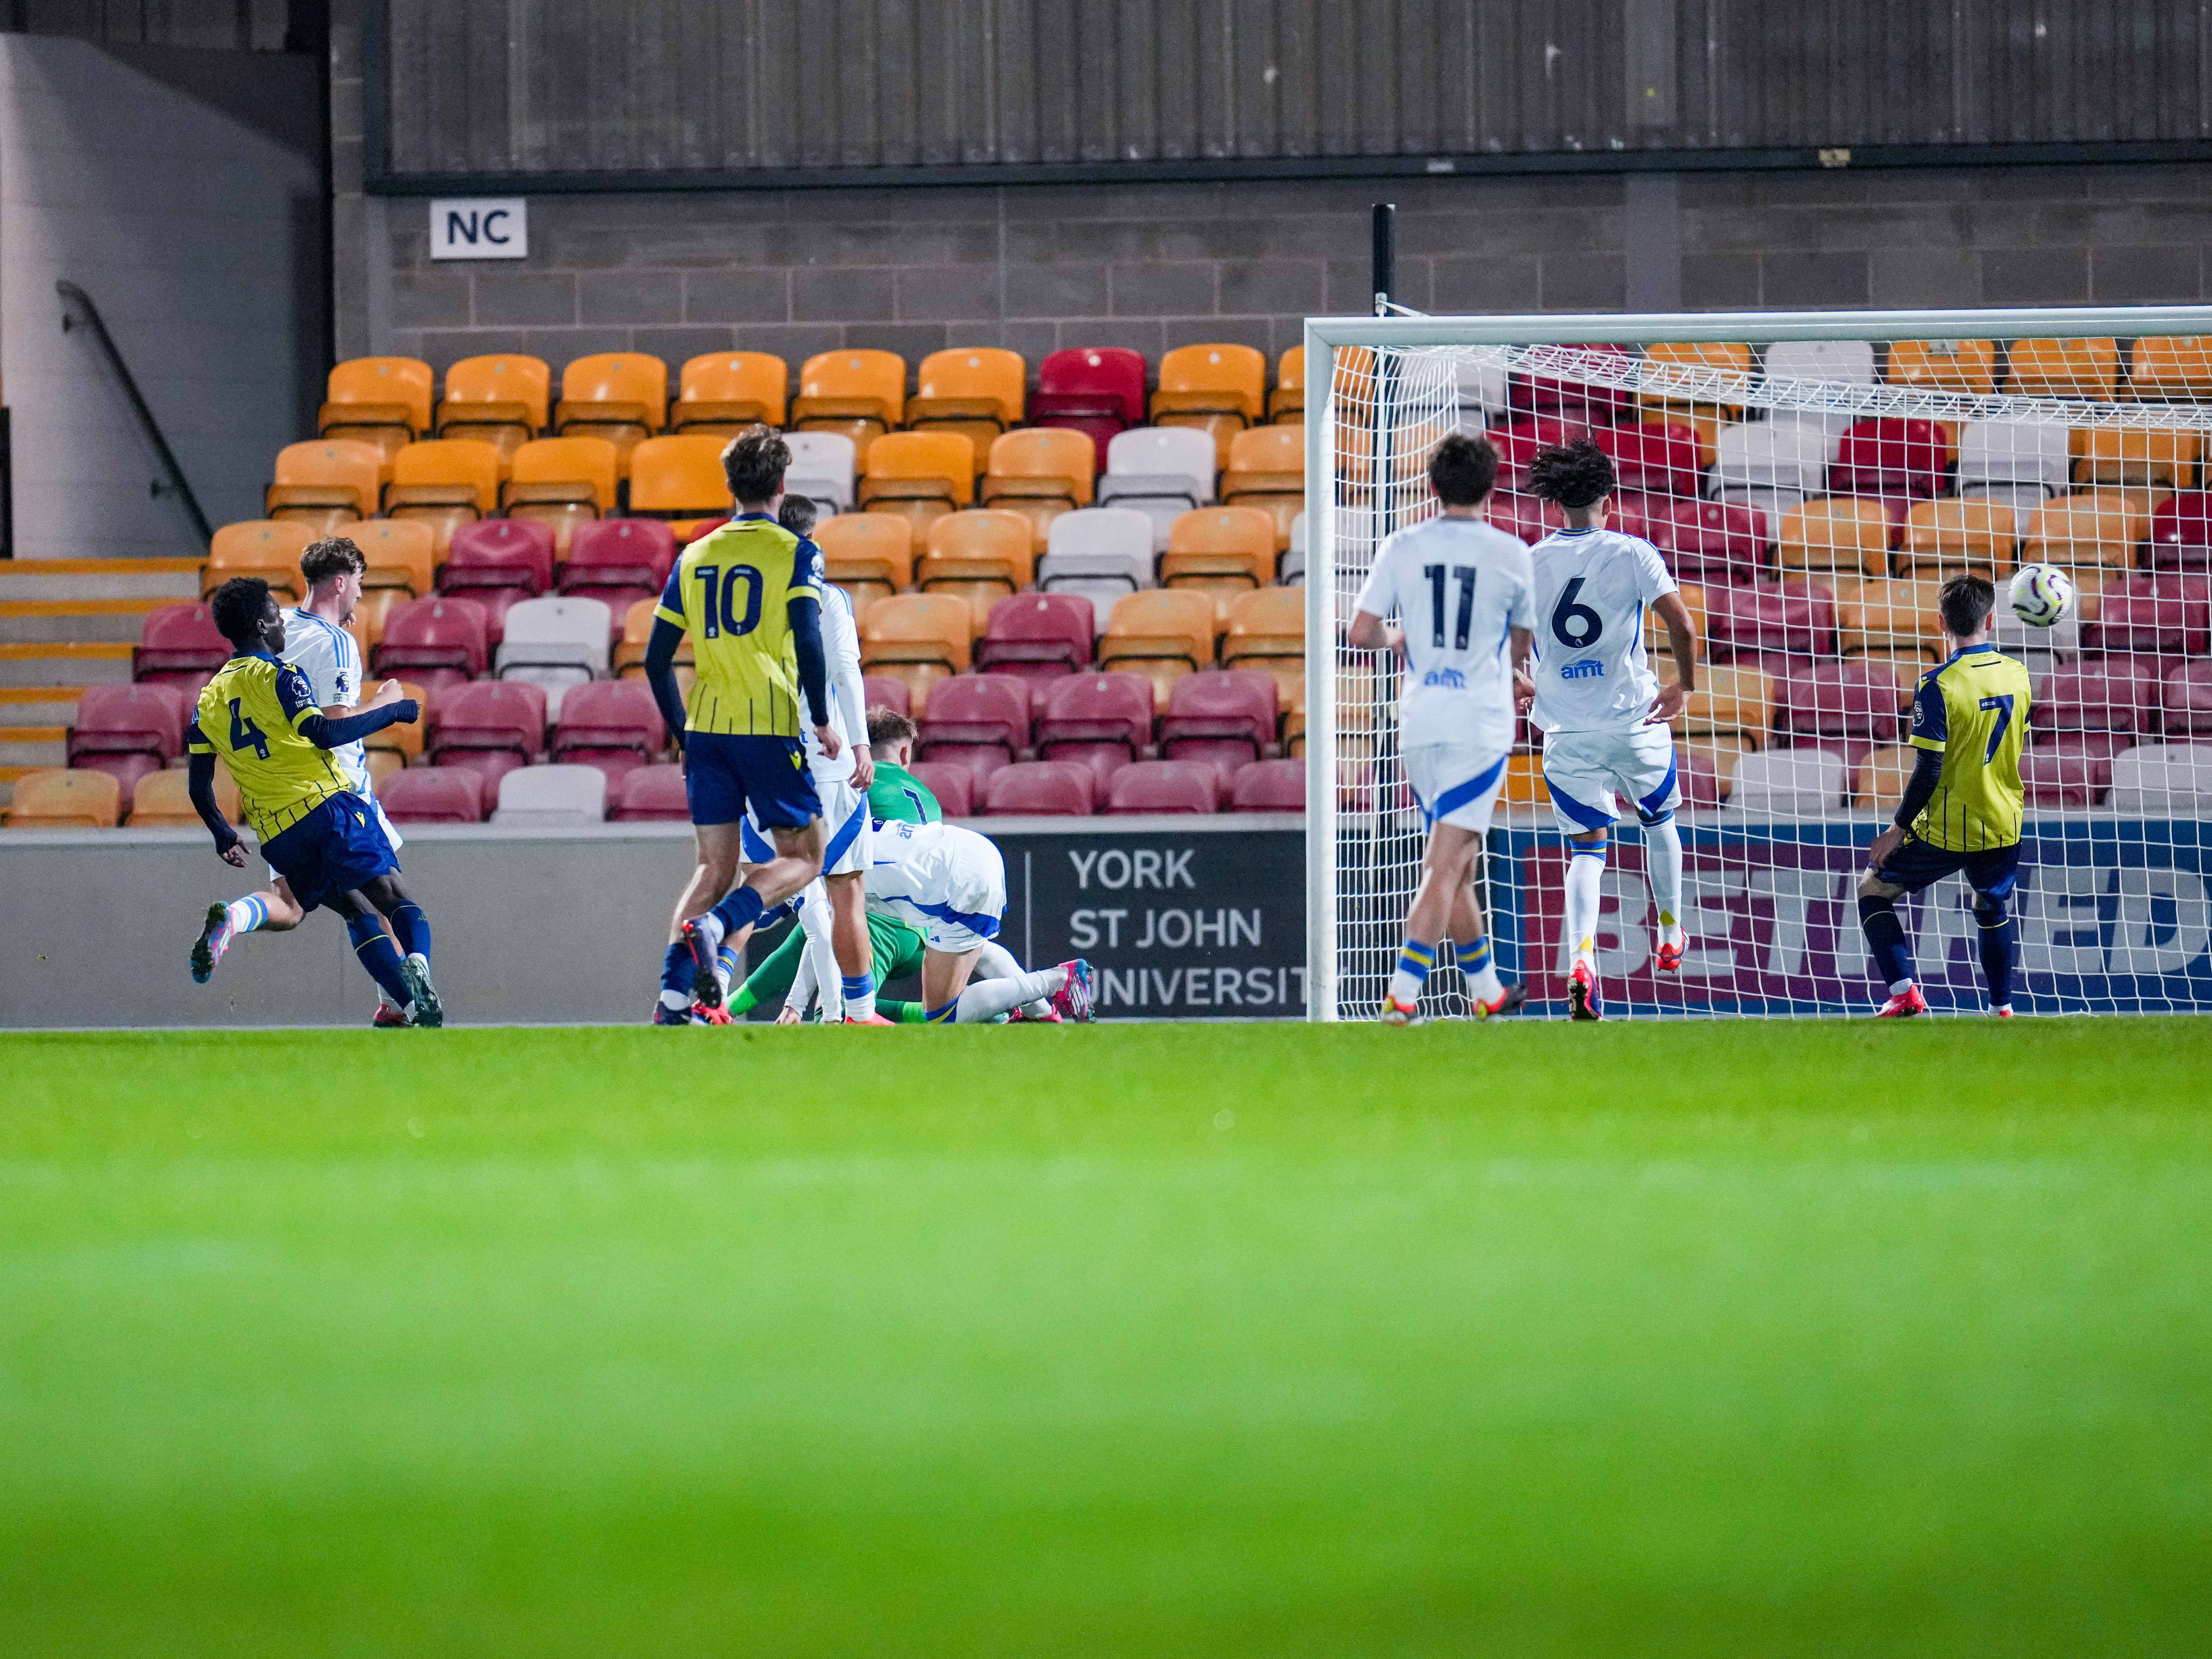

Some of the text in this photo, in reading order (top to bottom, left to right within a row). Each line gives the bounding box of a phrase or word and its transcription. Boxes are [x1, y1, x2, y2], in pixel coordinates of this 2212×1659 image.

[448, 210, 509, 244] NC
[695, 564, 763, 639] 10
[1424, 563, 1476, 650] 11
[1552, 578, 1602, 649] 6
[1561, 660, 1604, 679] amt
[229, 697, 271, 761] 4
[1979, 694, 2014, 766] 7
[901, 786, 927, 825] 1
[1068, 849, 1196, 890] YORK
[1069, 909, 1262, 949] ST JOHN
[1091, 966, 1307, 1007] NIVERSIT
